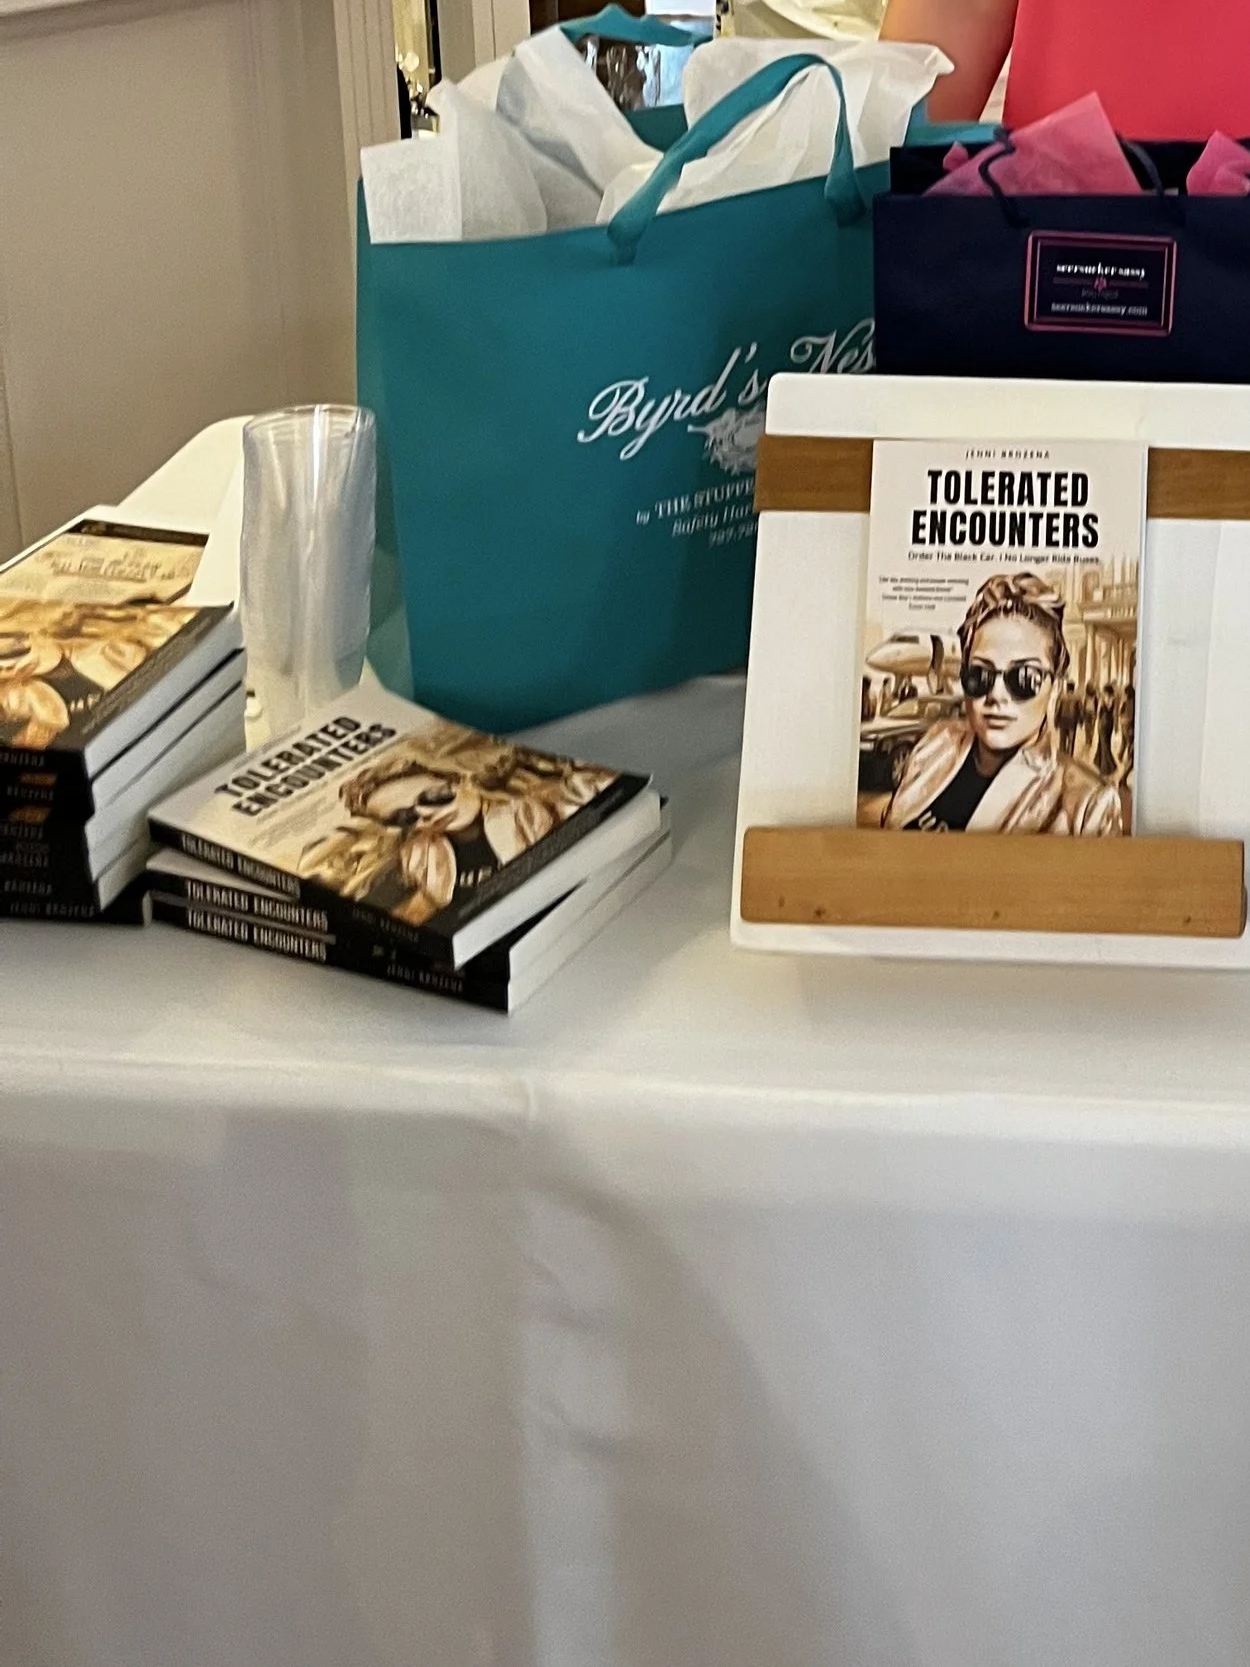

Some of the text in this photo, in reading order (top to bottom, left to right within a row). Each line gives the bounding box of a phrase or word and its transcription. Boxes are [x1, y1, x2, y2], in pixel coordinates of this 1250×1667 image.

[577, 318, 877, 461] Byrd's Nes
[927, 469, 1090, 508] TOLERATED
[911, 509, 1099, 548] ENCOUNTERS
[214, 716, 361, 797] TOLERATED
[231, 723, 397, 816] ENCOUNTERS
[187, 879, 329, 934] TOLERATED ENCOUNTERS
[187, 909, 328, 964] TOLERATED ENCOUNTERS
